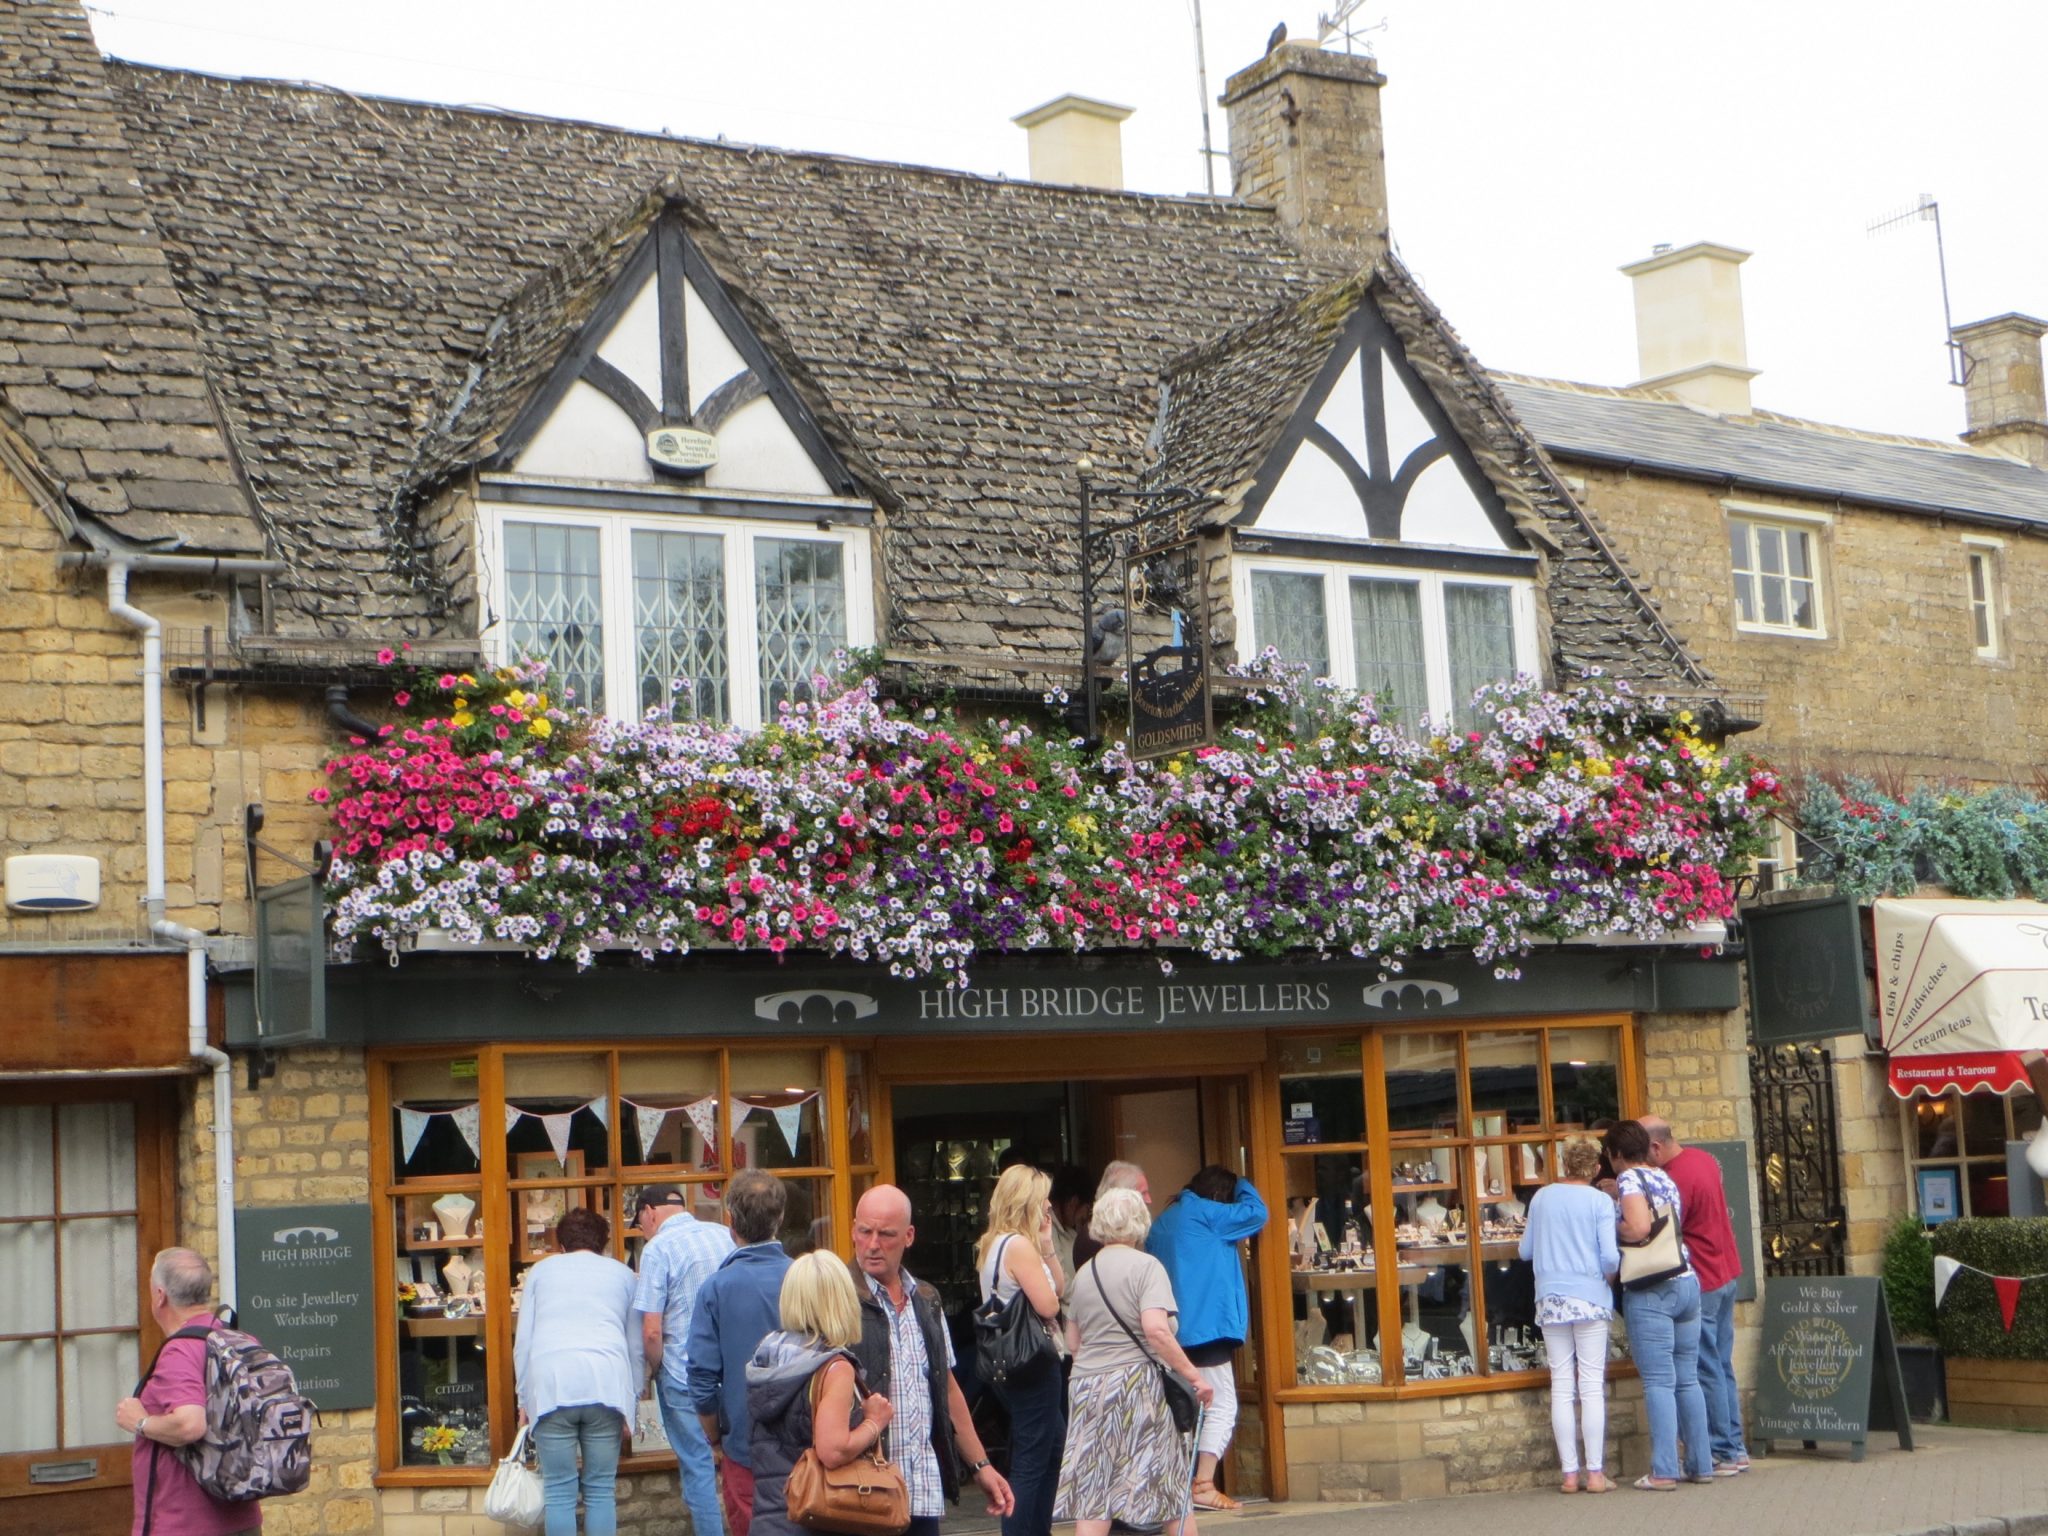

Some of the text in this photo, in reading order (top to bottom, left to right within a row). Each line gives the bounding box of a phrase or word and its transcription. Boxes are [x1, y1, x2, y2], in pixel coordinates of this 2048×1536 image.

[1137, 721, 1204, 748] GOLDSMITHS
[1886, 932, 1904, 1017] fish & chips
[918, 982, 1331, 1024] HIGH BRIDGE JEWELLERS
[1902, 962, 1949, 1029] sandwiches
[1912, 1015, 1972, 1050] cream teas
[1897, 1065, 1997, 1078] Restaurant & Tearoom
[261, 1246, 353, 1262] HIGH BRIDGE
[252, 1291, 360, 1309] On site Jewellery
[1799, 1286, 1843, 1300] We Buy
[1781, 1301, 1859, 1314] Gold & Silver
[274, 1312, 339, 1327] Workshop
[283, 1345, 332, 1361] Repairs
[1832, 1344, 1863, 1357] Hand
[1789, 1357, 1841, 1373] Jewellery
[296, 1377, 340, 1391] uations
[1804, 1373, 1837, 1385] Silver
[434, 1383, 474, 1395] CITIZEN
[1789, 1402, 1838, 1418] Antique,
[1759, 1416, 1860, 1433] Vintage & Modern
